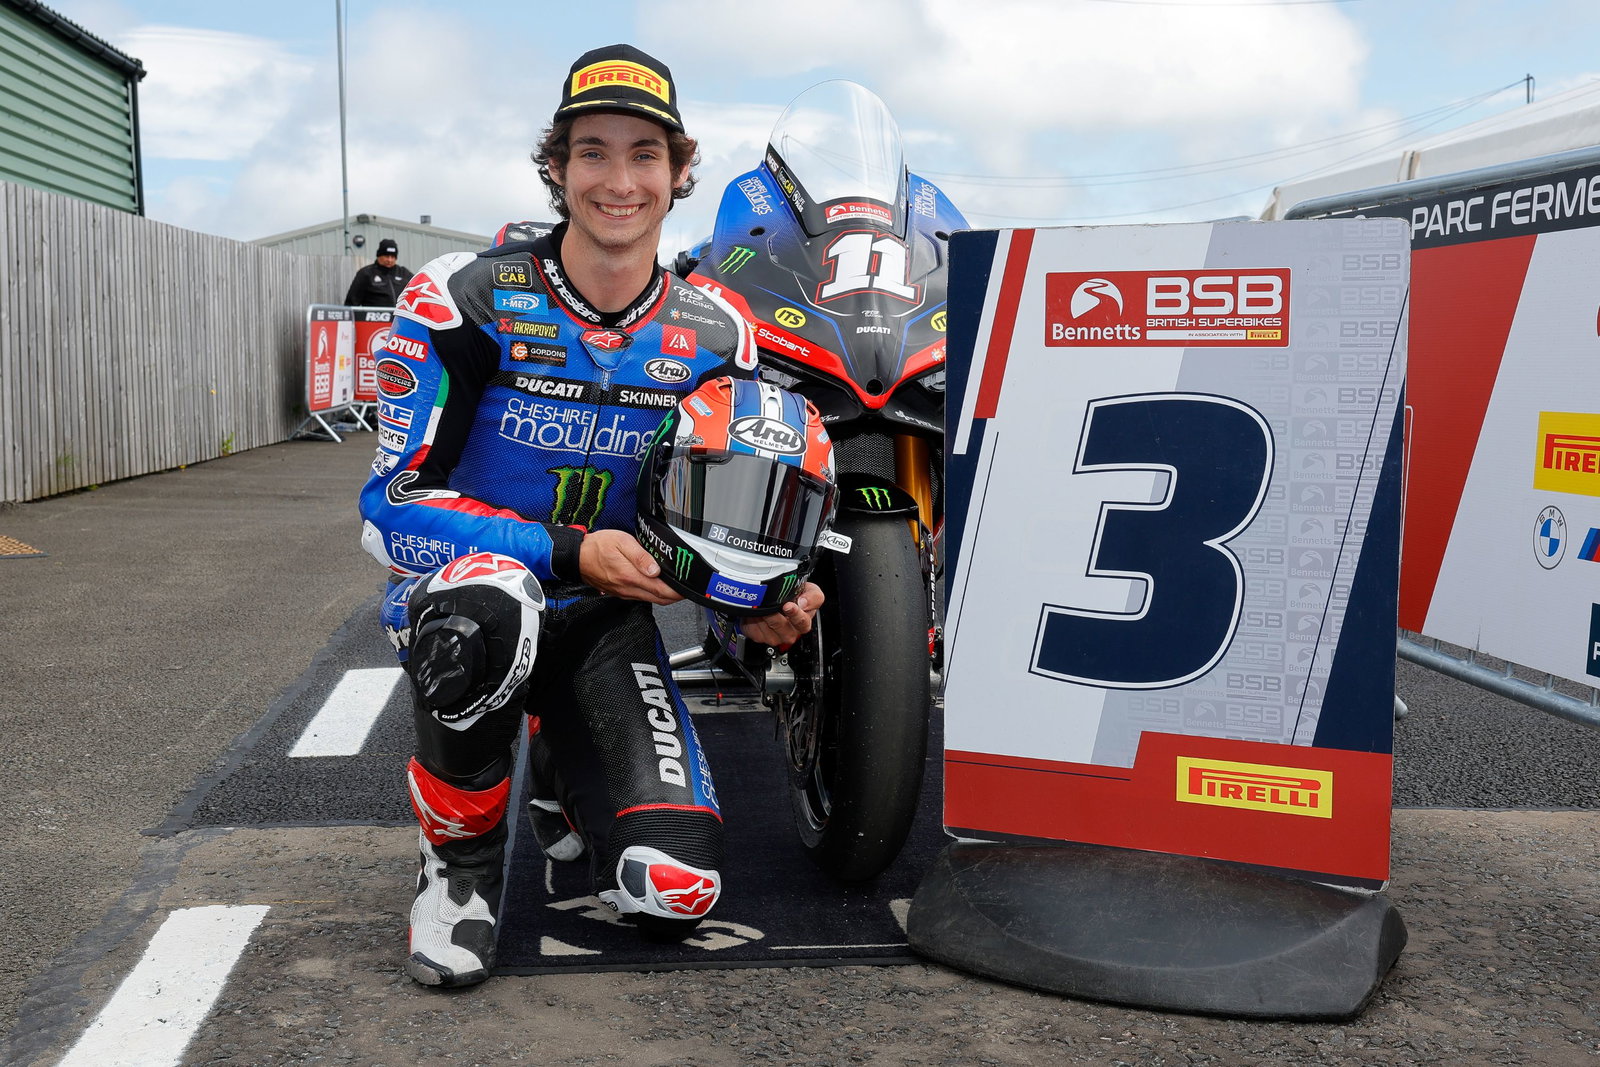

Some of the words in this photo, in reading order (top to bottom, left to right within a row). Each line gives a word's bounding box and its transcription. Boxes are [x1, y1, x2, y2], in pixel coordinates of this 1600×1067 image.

[578, 65, 661, 95] PIRELLI
[849, 205, 889, 219] Bennetts
[1411, 196, 1484, 240] PARC
[500, 264, 524, 273] fona
[821, 233, 915, 300] 11
[1342, 254, 1401, 270] BSB
[499, 272, 526, 284] CAB
[679, 296, 714, 311] RACING
[1146, 275, 1283, 316] BSB
[1340, 287, 1400, 304] BSB
[366, 312, 391, 321] R&G
[681, 311, 726, 328] Stobart
[777, 309, 803, 326] ITS
[1146, 318, 1195, 327] BRITISH
[1198, 317, 1282, 327] SUPERBIKES
[856, 326, 891, 335] DUCATI
[1052, 323, 1141, 340] Bennetts
[757, 328, 811, 357] Stobart
[530, 347, 566, 358] GORDONS
[651, 361, 686, 377] Arai
[515, 377, 584, 398] DUCATI
[1337, 388, 1396, 404] BSB
[619, 390, 677, 407] SKINNER
[508, 397, 592, 426] CHESHIRE
[499, 411, 656, 461] moulding
[732, 418, 800, 449] Arai
[1543, 433, 1600, 474] PIRE
[1292, 504, 1333, 513] Bennetts
[390, 531, 450, 554] CHESHIRE
[710, 525, 727, 540] 3b
[727, 534, 793, 558] construction
[1028, 391, 1276, 690] 3
[1291, 536, 1332, 545] Bennetts
[1290, 568, 1331, 578] Bennetts
[1247, 580, 1284, 598] SB
[1290, 600, 1328, 610] Bennett
[1241, 611, 1283, 628] SB
[1226, 673, 1282, 692] BSB
[1128, 696, 1180, 714] BSB
[1226, 704, 1281, 723] BSB
[631, 662, 686, 788] DUCATI
[1188, 767, 1321, 808] PIRELLI
